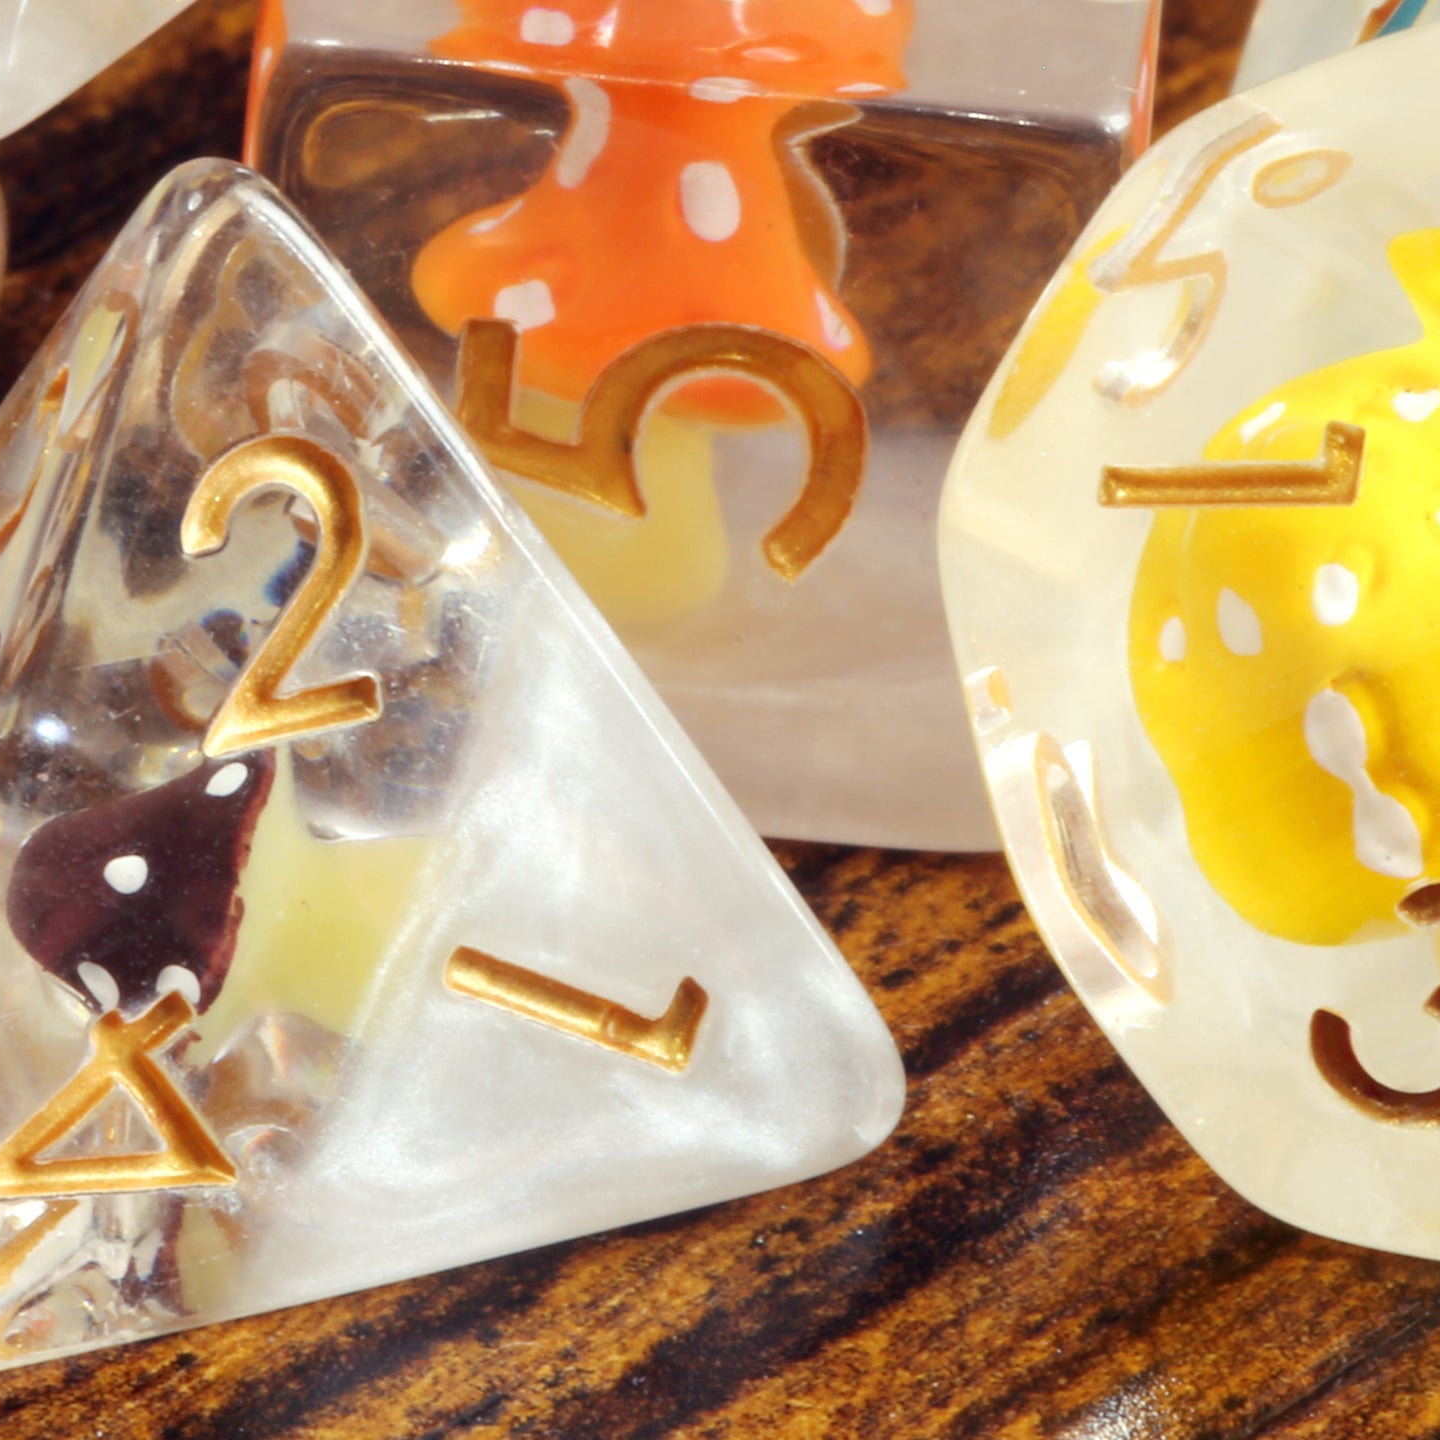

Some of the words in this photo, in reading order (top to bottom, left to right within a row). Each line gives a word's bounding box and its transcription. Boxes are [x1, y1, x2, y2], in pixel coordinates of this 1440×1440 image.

[459, 318, 868, 585] 5
[181, 433, 382, 757] 2
[442, 945, 710, 1074] 1
